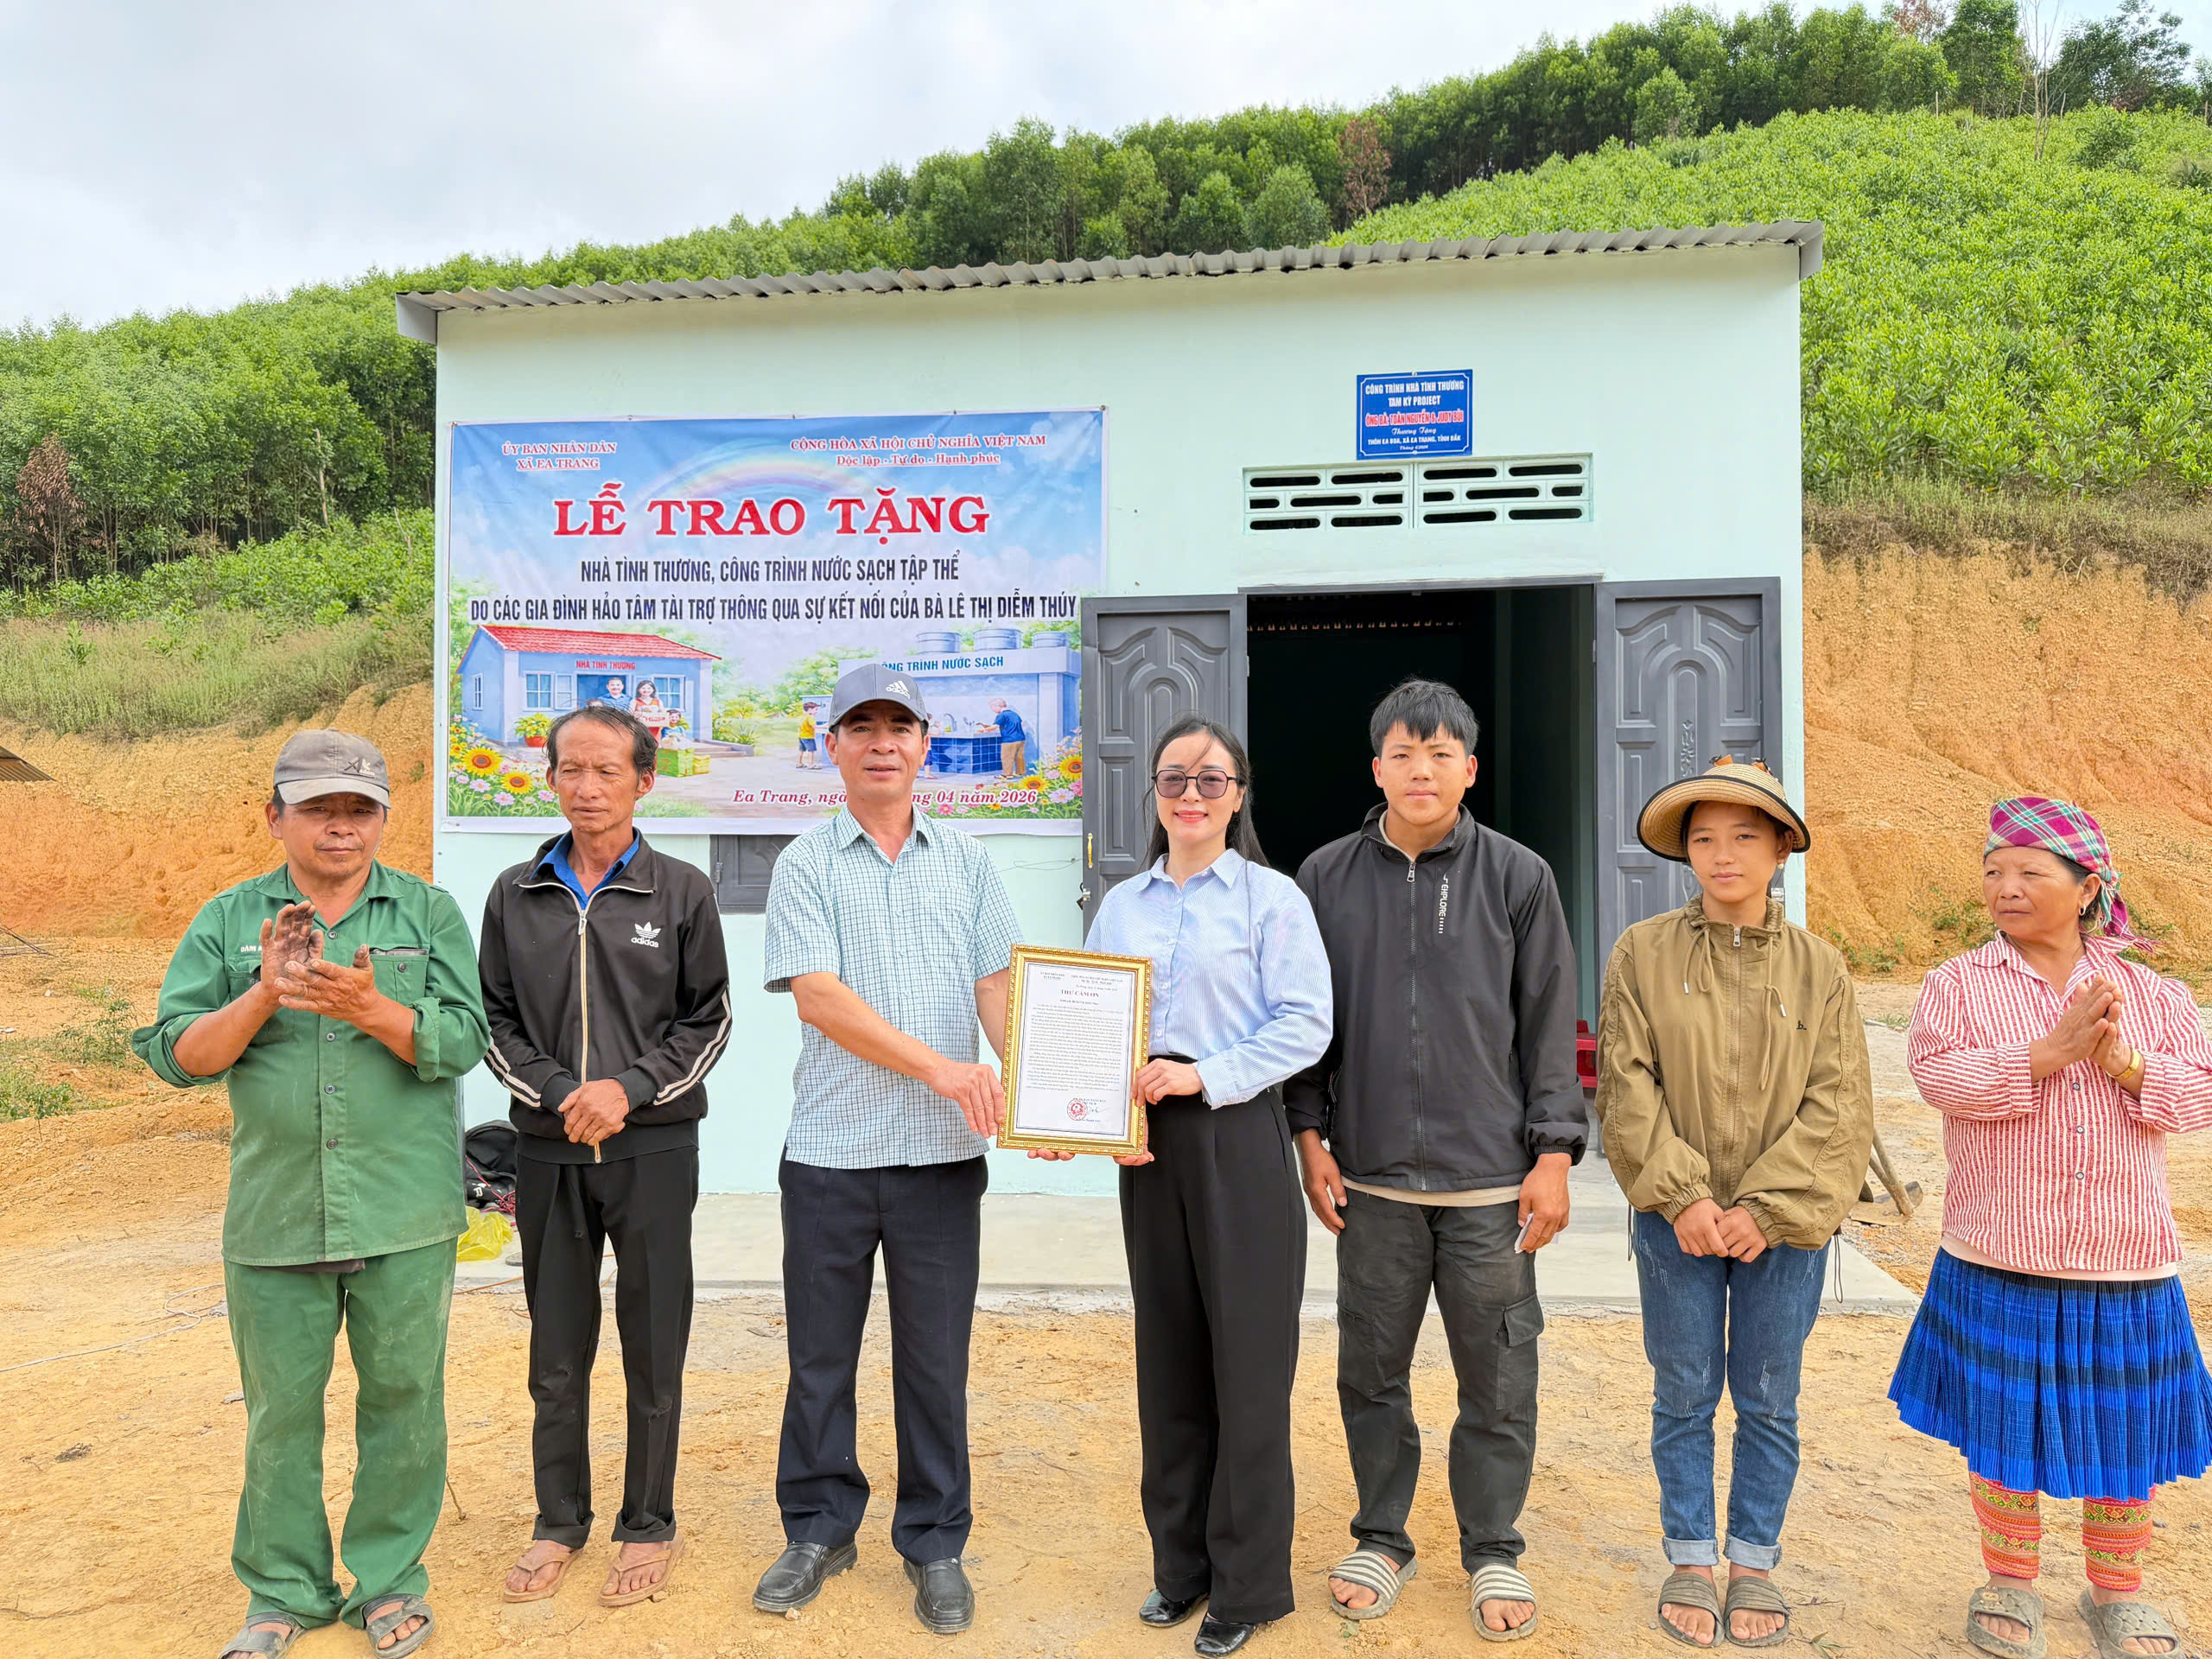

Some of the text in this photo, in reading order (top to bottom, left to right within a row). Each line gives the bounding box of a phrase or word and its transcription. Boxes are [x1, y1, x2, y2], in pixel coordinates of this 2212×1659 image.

[1414, 395, 1440, 406] PROJECT
[503, 441, 616, 454] ỦY BAN NHÂN DÂN
[791, 435, 1046, 451] CỘNG HÒA XÃ HỘI CHỦ NGHĨA VIỆT NAM
[518, 458, 600, 468] XÃ EA TRANG
[837, 455, 859, 467] Độc
[863, 455, 880, 467] lập
[892, 454, 908, 466] Tự
[911, 454, 925, 464] do
[936, 454, 967, 465] Hạnh
[970, 454, 1000, 465] phúc
[553, 482, 990, 545] LỄ TRAO TẶNG
[581, 549, 961, 586] NHÀ TÌNH THƯƠNG, CÔNG TRÌNH NƯỚC SẠCH TẬP THỂ
[471, 588, 1077, 625] DO CÁC GIA ĐÌNH HẢO TÂM TÀI TRỢ THÔNG QUA SỰ KẾT NỐI CỦA BÀ LÊ THỊ DIỄM THÚY
[881, 656, 1003, 671] ÔNG TRÌNH NƯỚC SẠCH
[733, 790, 754, 802] Ea
[760, 790, 812, 806] Trang,
[818, 790, 848, 806] ngà
[938, 791, 954, 803] 04
[960, 791, 995, 803] năm
[1001, 790, 1037, 803] 2026
[631, 937, 659, 948] adidas
